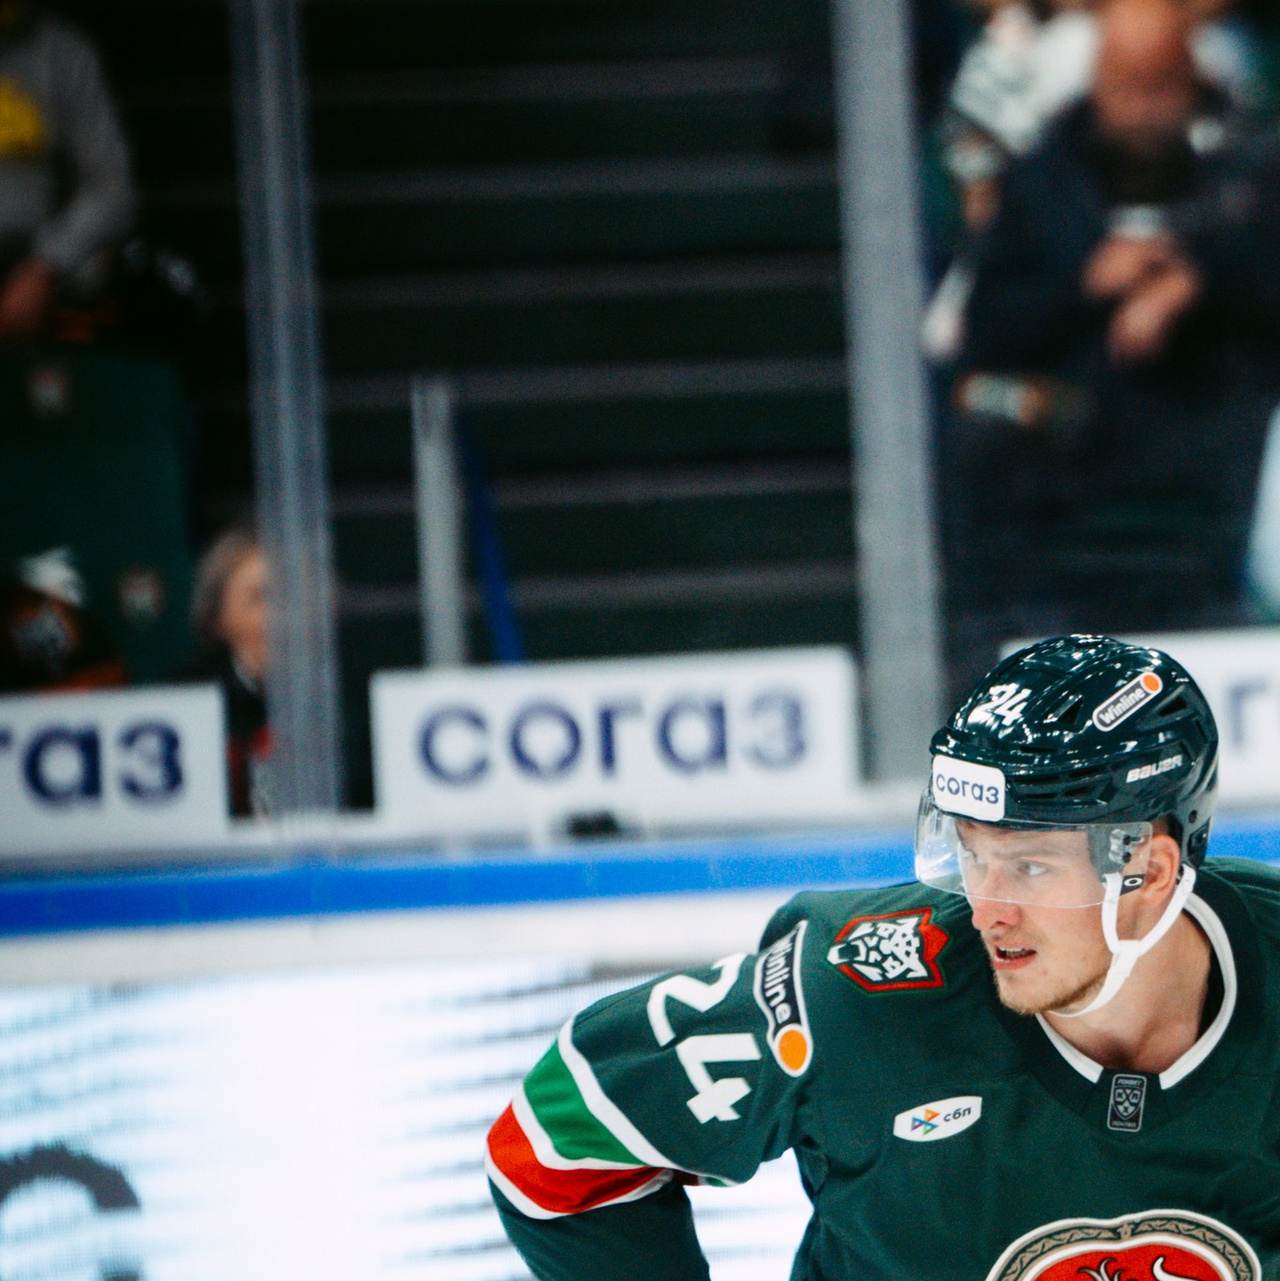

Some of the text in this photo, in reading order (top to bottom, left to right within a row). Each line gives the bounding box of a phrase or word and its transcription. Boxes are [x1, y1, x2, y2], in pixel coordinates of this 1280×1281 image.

[0, 722, 184, 806] аз
[417, 685, 808, 785] согаз
[936, 773, 999, 804] согаз
[647, 953, 762, 1124] 24
[943, 1107, 972, 1124] сбп
